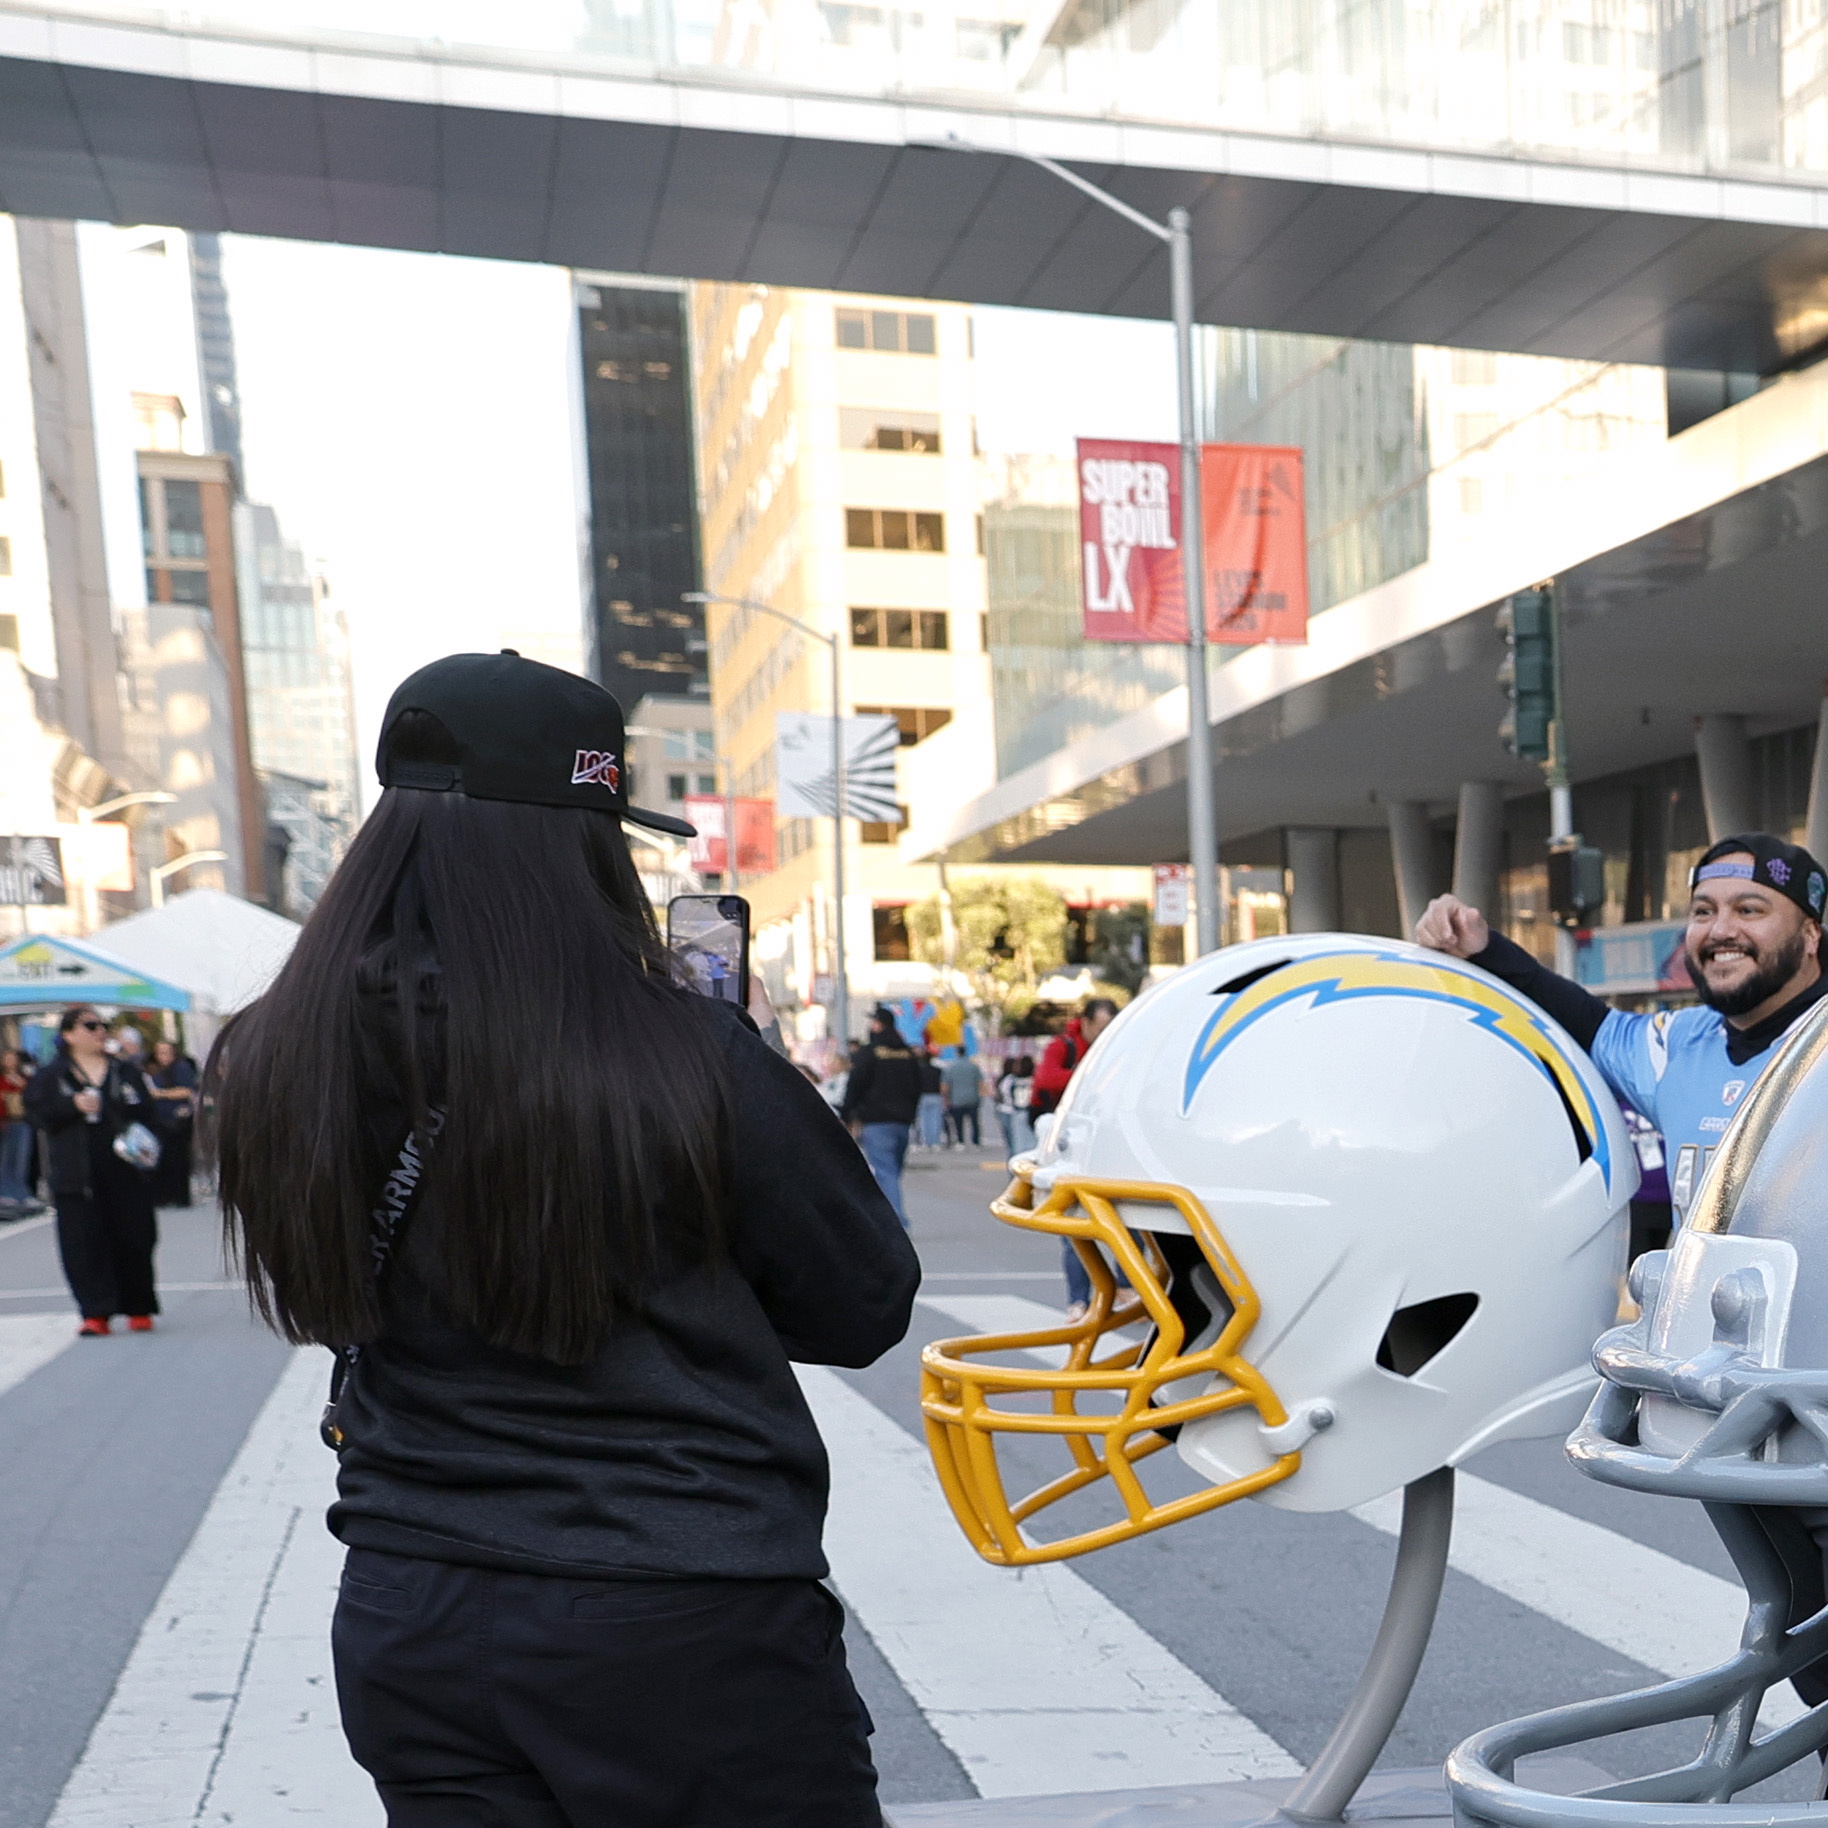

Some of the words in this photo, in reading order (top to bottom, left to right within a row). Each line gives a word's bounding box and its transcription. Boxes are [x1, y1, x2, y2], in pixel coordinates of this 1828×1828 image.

[1082, 458, 1169, 504] SUPER
[1101, 502, 1177, 550] BOWL
[1084, 540, 1135, 613] LX
